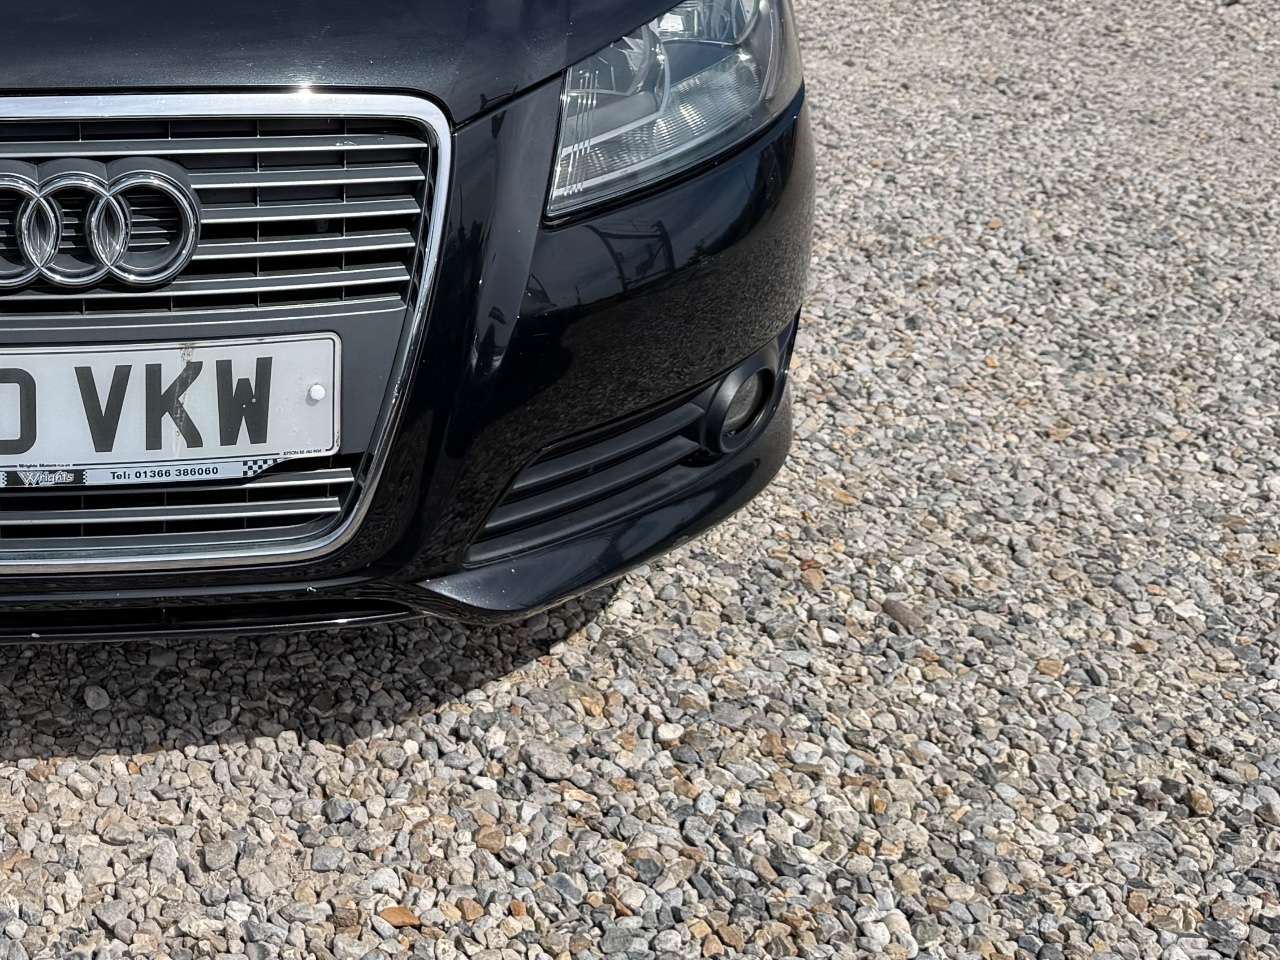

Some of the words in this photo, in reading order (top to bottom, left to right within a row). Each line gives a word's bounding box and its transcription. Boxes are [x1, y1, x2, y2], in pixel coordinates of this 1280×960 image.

[74, 356, 273, 453] VKW
[110, 471, 131, 480] Tel:
[135, 469, 171, 479] 01366
[175, 466, 219, 477] 386060
